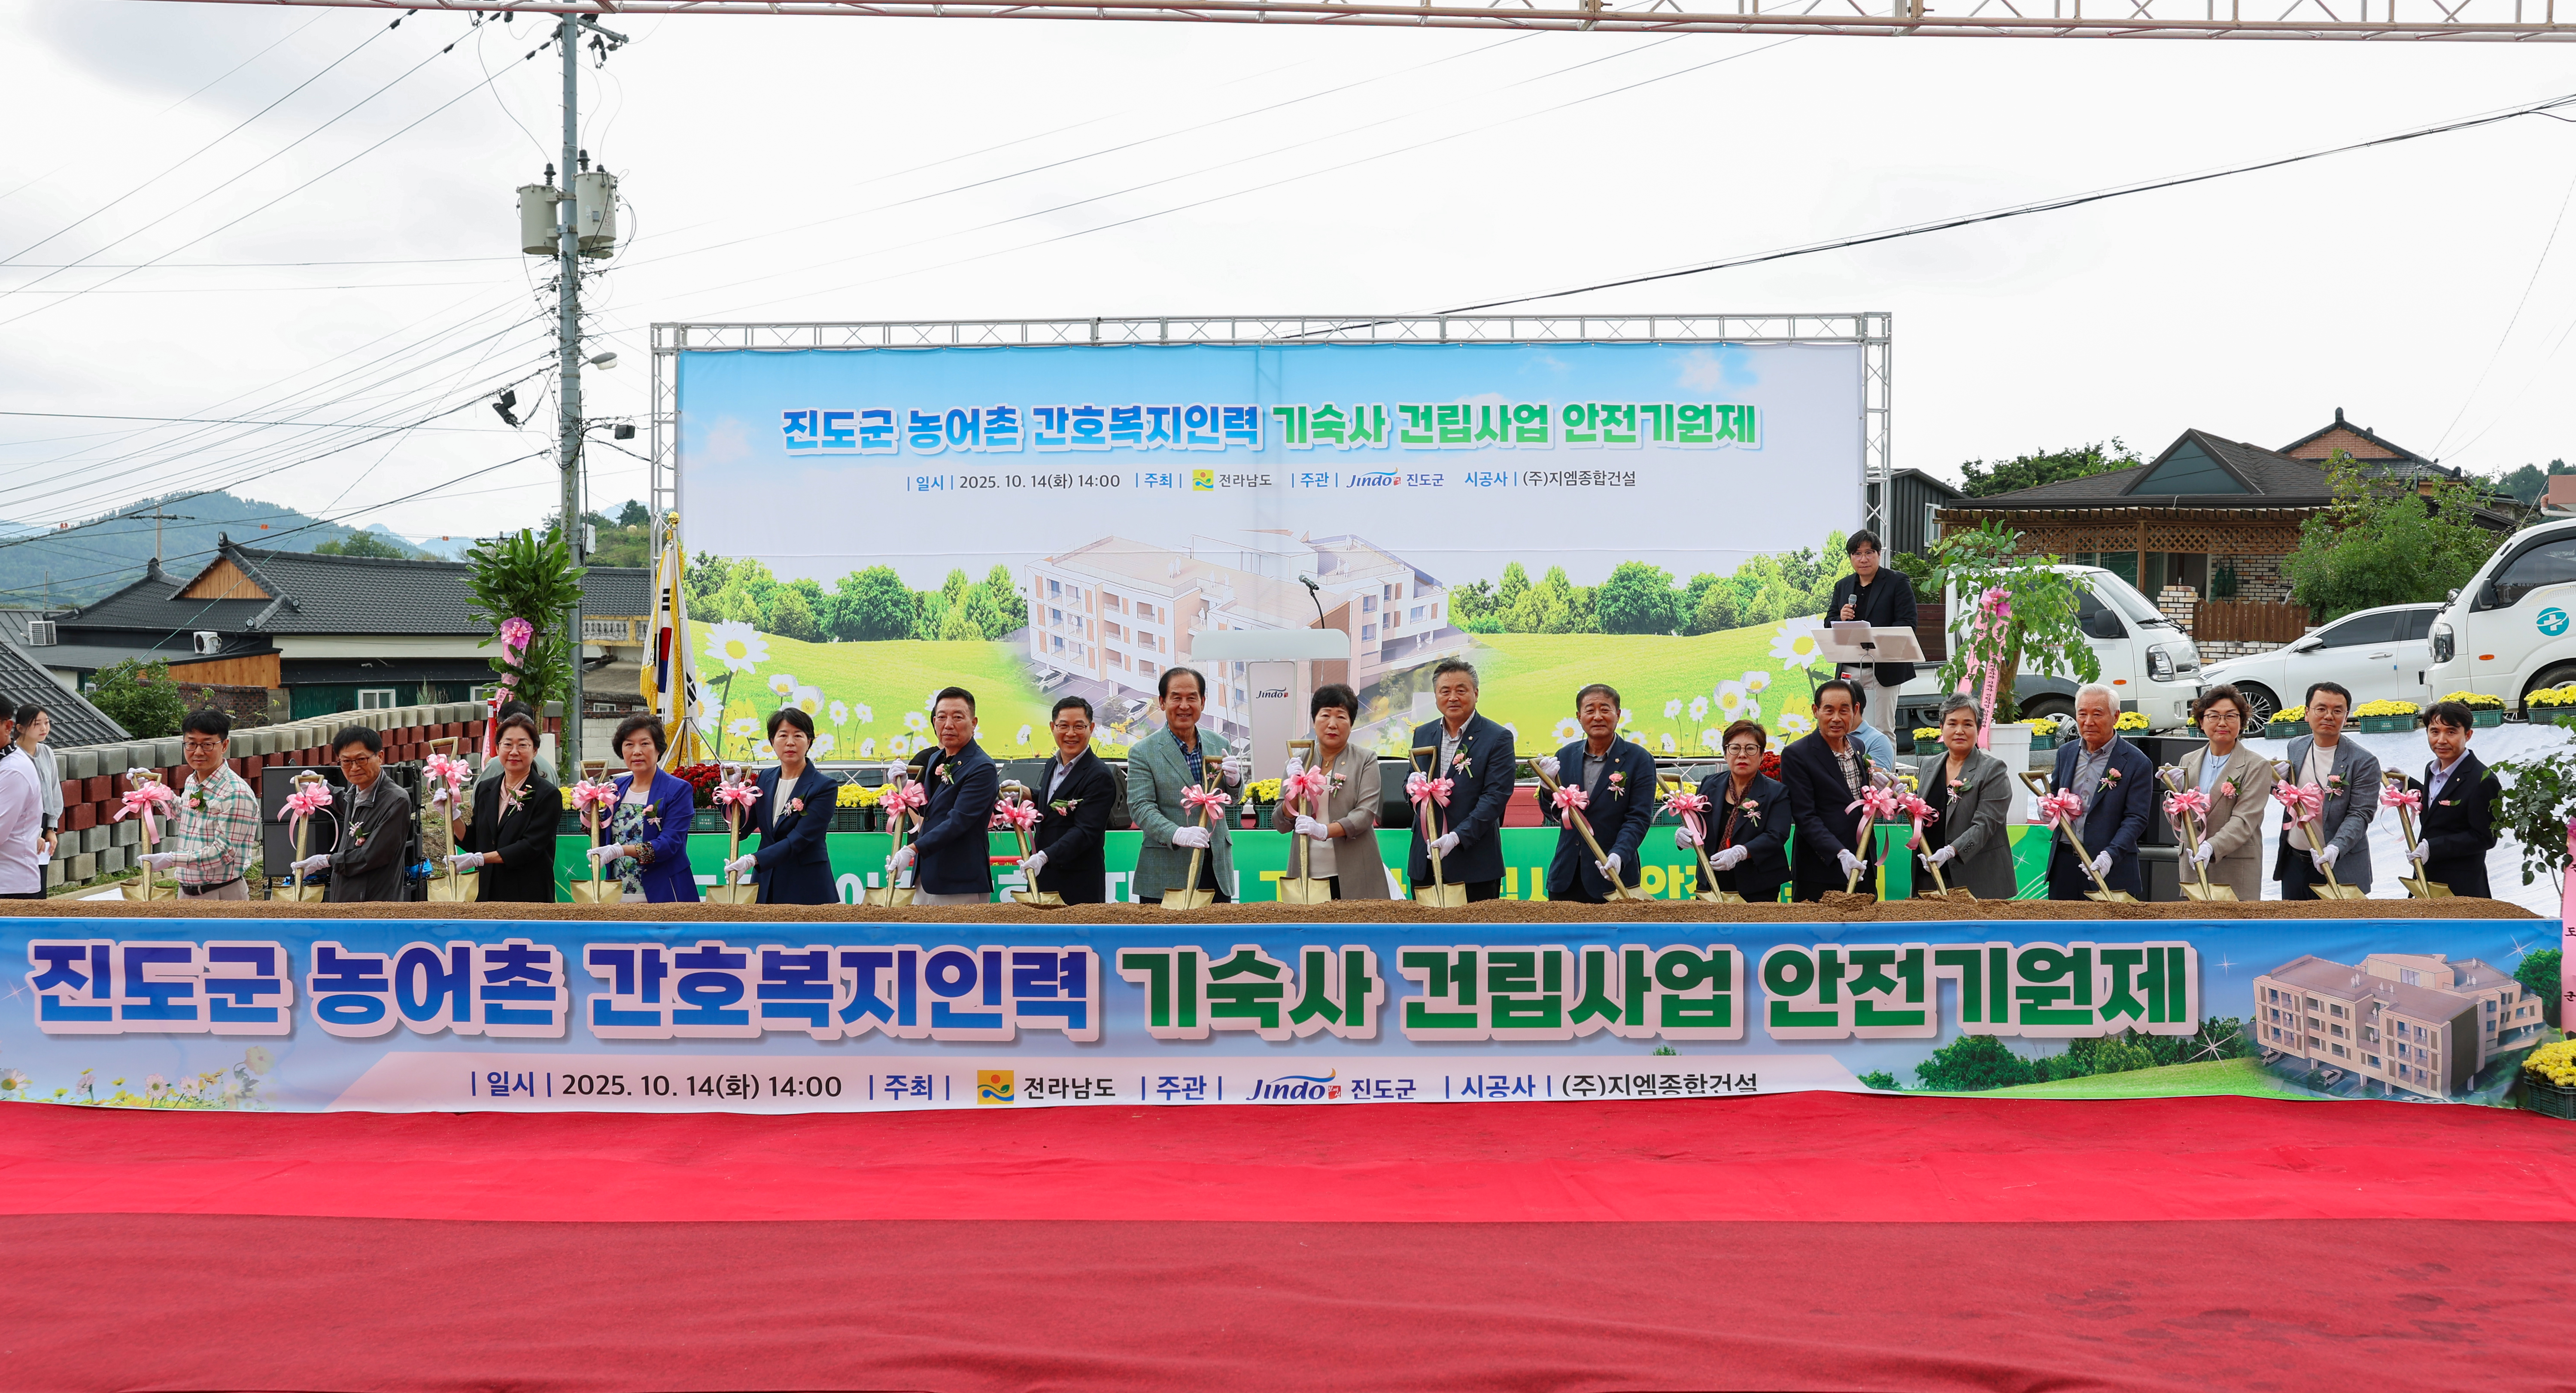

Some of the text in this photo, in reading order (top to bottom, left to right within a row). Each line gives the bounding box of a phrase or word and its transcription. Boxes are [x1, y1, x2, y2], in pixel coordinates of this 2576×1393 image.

[781, 402, 1755, 449] 진도군 농어촌 간호복지인력 기숙사 건립사업 안전기원제
[916, 475, 944, 491] 일시
[960, 476, 1000, 489] 2025.
[1005, 475, 1026, 488] 10.
[1031, 473, 1073, 489] 14(화)
[1078, 474, 1120, 487] 14:00
[1144, 473, 1172, 488] 주최
[1219, 473, 1272, 488] 전라남도
[1300, 472, 1329, 488] 주관
[1346, 475, 1392, 488] Jindo
[1406, 473, 1444, 487] 진도군
[1464, 471, 1508, 487] 시공사
[1523, 470, 1636, 487] (주)지엠종합건설
[1256, 690, 1283, 699] Jindo
[32, 944, 2186, 1029] 진도군 농어촌 간호복지인력 기숙사 건립사업 안전기원제
[486, 1071, 535, 1098] 일시
[562, 1074, 632, 1096] 2025.
[641, 1075, 677, 1097] 10.
[687, 1073, 760, 1099] 14(화)
[769, 1075, 842, 1098] 14:00
[884, 1074, 933, 1100] 주최
[1024, 1076, 1116, 1099] 전라남도
[1156, 1075, 1206, 1100] 주관
[1245, 1079, 1325, 1100] Jindo
[1351, 1078, 1416, 1100] 진도군
[1461, 1074, 1536, 1098] 시공사
[1562, 1073, 1759, 1097] (주)지엠종합건설
